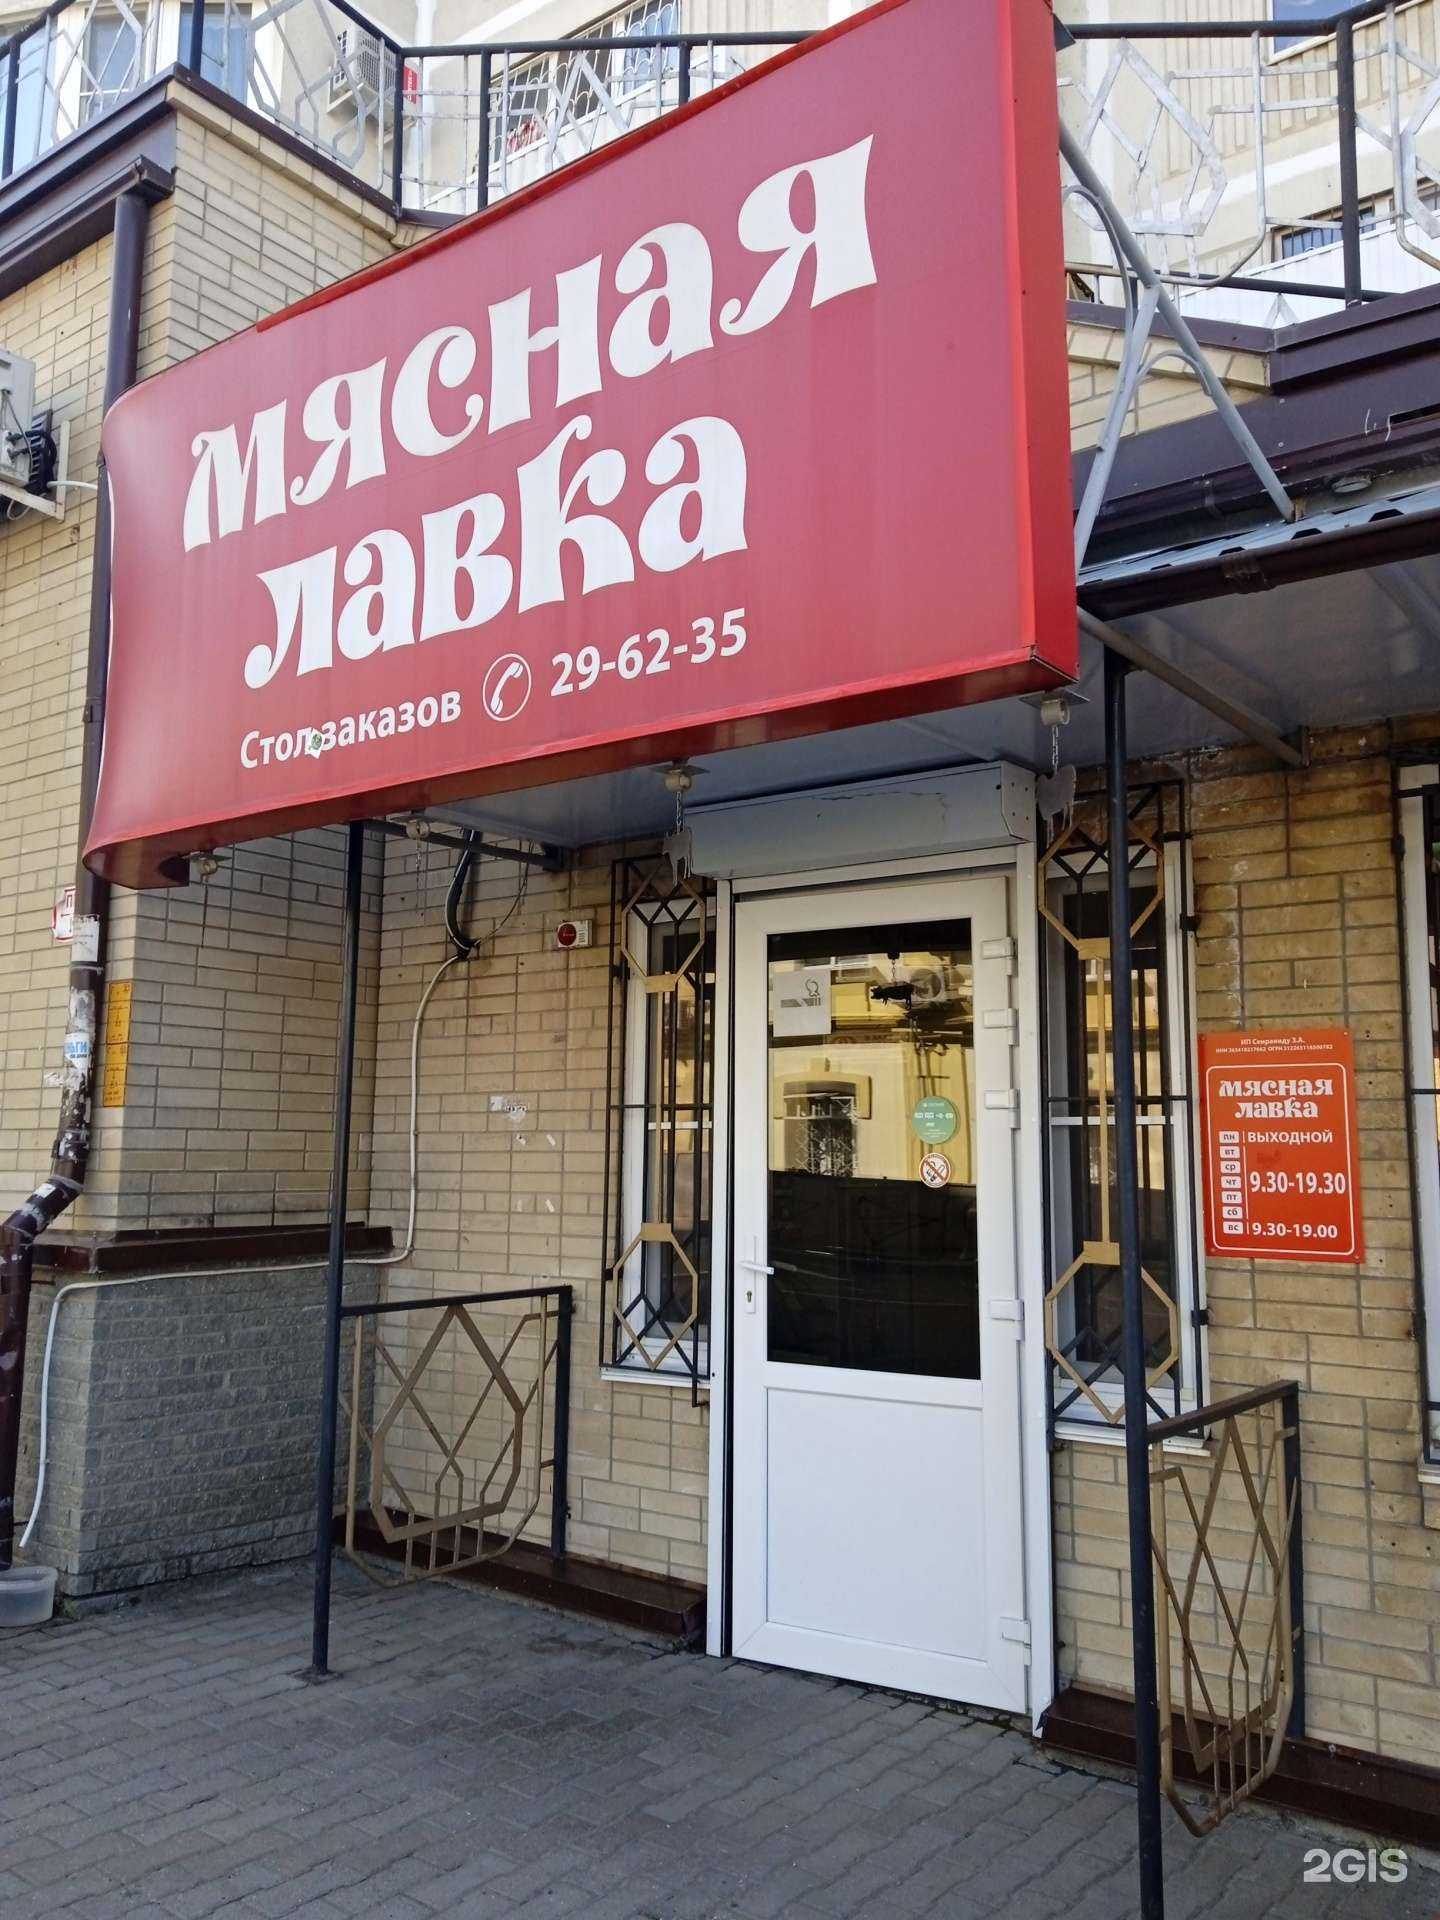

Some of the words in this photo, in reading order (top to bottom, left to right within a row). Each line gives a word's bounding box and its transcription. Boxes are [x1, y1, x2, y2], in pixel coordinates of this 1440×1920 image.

[320, 691, 462, 751] заказов
[550, 607, 748, 697] 29-62-35
[1250, 1171, 1346, 1194] 9.30-19.30
[1253, 1222, 1338, 1239] 9.30-19.00
